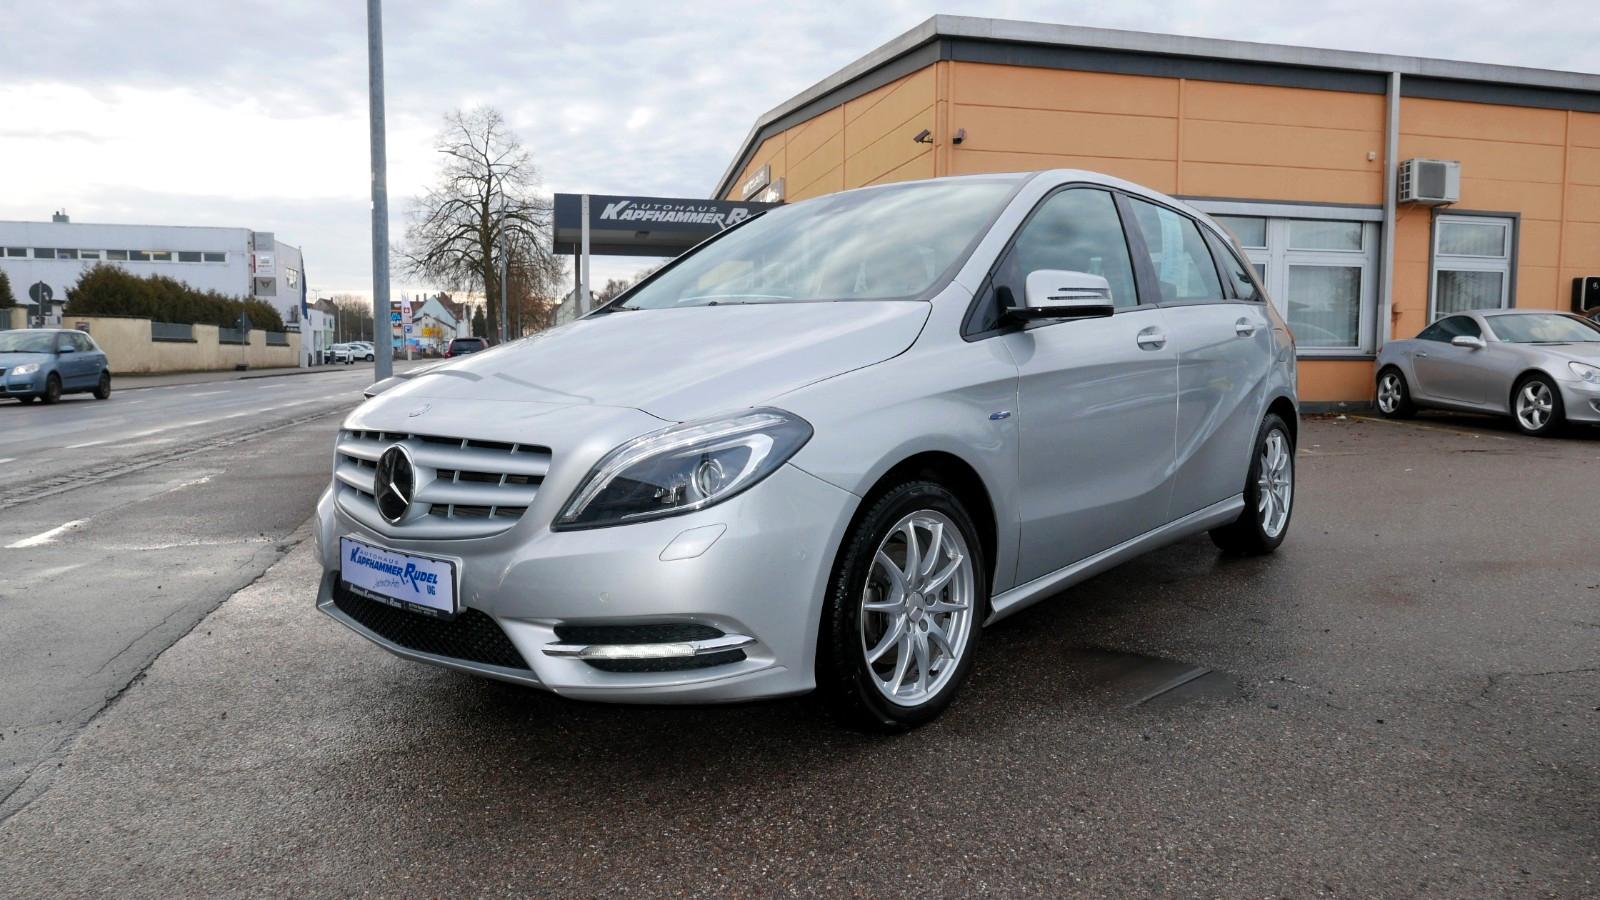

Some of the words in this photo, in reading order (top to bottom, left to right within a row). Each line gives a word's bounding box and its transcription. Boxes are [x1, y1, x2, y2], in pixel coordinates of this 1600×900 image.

[600, 200, 726, 228] KAPFHAMMER
[628, 203, 718, 212] AUTOHAUS
[360, 550, 399, 565] AUTOHAUS
[404, 563, 438, 592] RUDEL
[427, 585, 436, 596] UG
